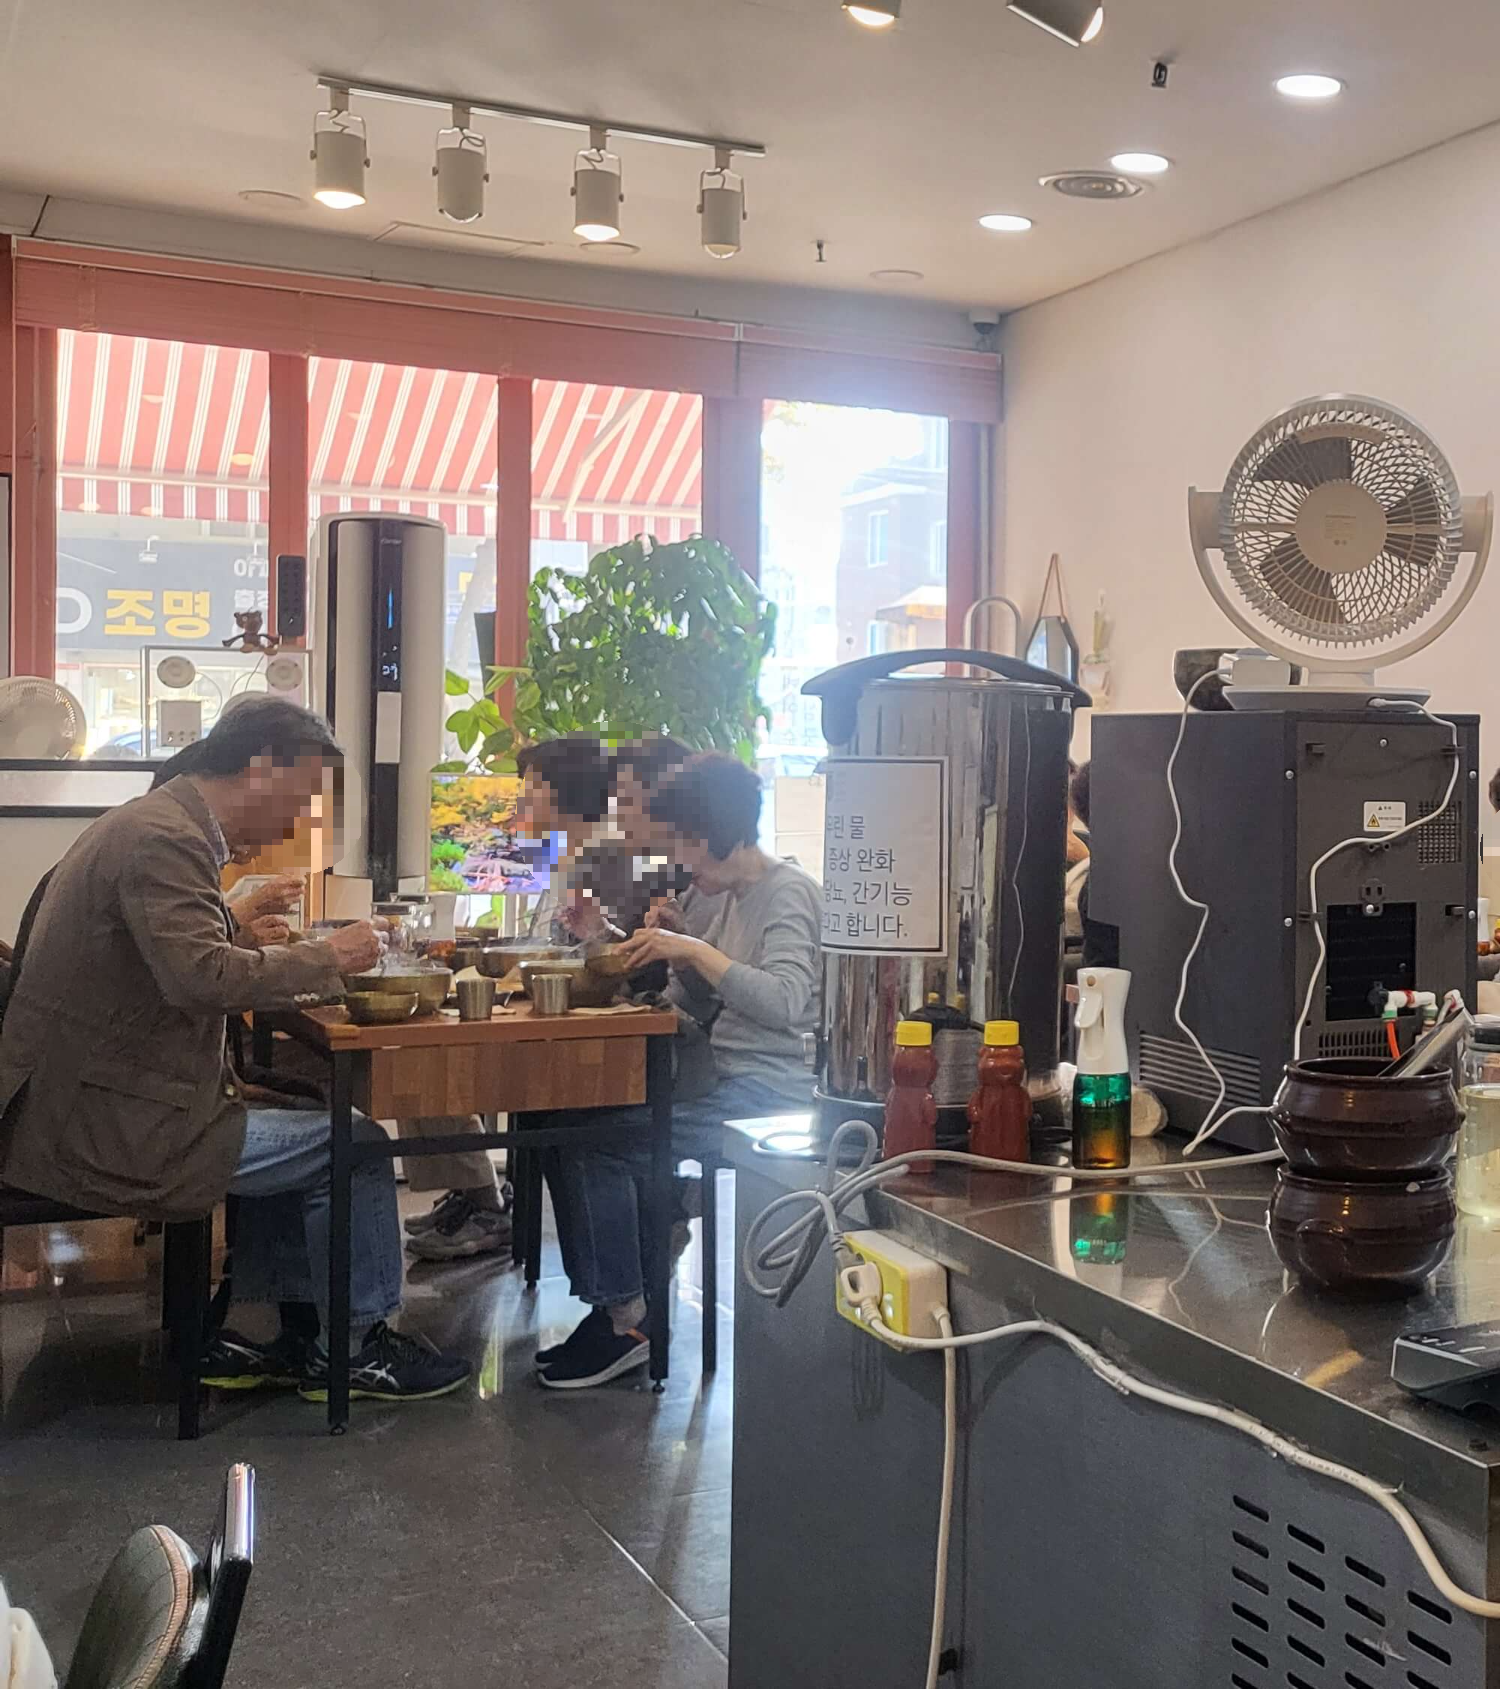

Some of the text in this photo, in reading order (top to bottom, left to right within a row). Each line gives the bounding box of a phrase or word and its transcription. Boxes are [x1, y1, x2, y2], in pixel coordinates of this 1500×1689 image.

[104, 589, 211, 639] 조명
[850, 815, 865, 840] 물
[856, 849, 896, 874] 완화
[852, 881, 913, 906] 간기능
[846, 912, 908, 939] 합니다.
